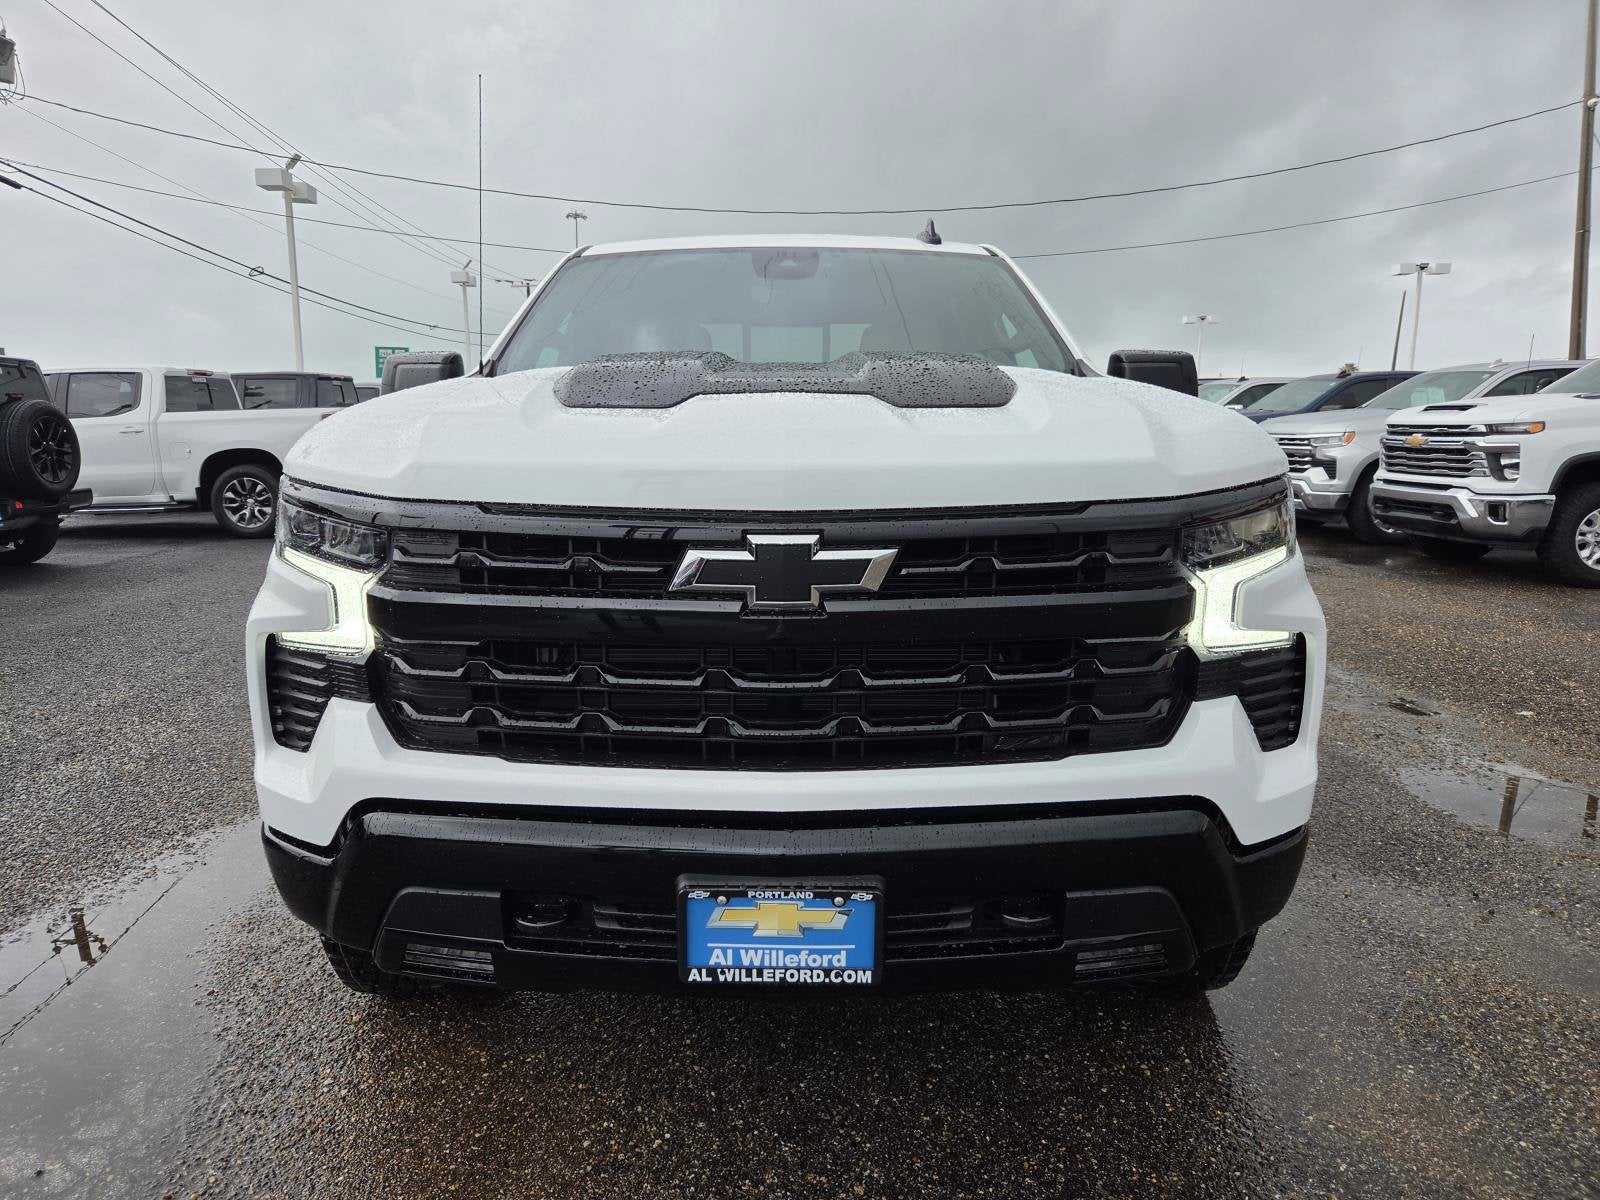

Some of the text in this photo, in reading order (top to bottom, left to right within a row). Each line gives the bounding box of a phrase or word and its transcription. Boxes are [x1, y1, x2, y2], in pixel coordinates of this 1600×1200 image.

[747, 891, 814, 899] PORTLAND
[708, 948, 847, 968] Al Willeford
[687, 968, 872, 984] AL WILLEFORD.COM
